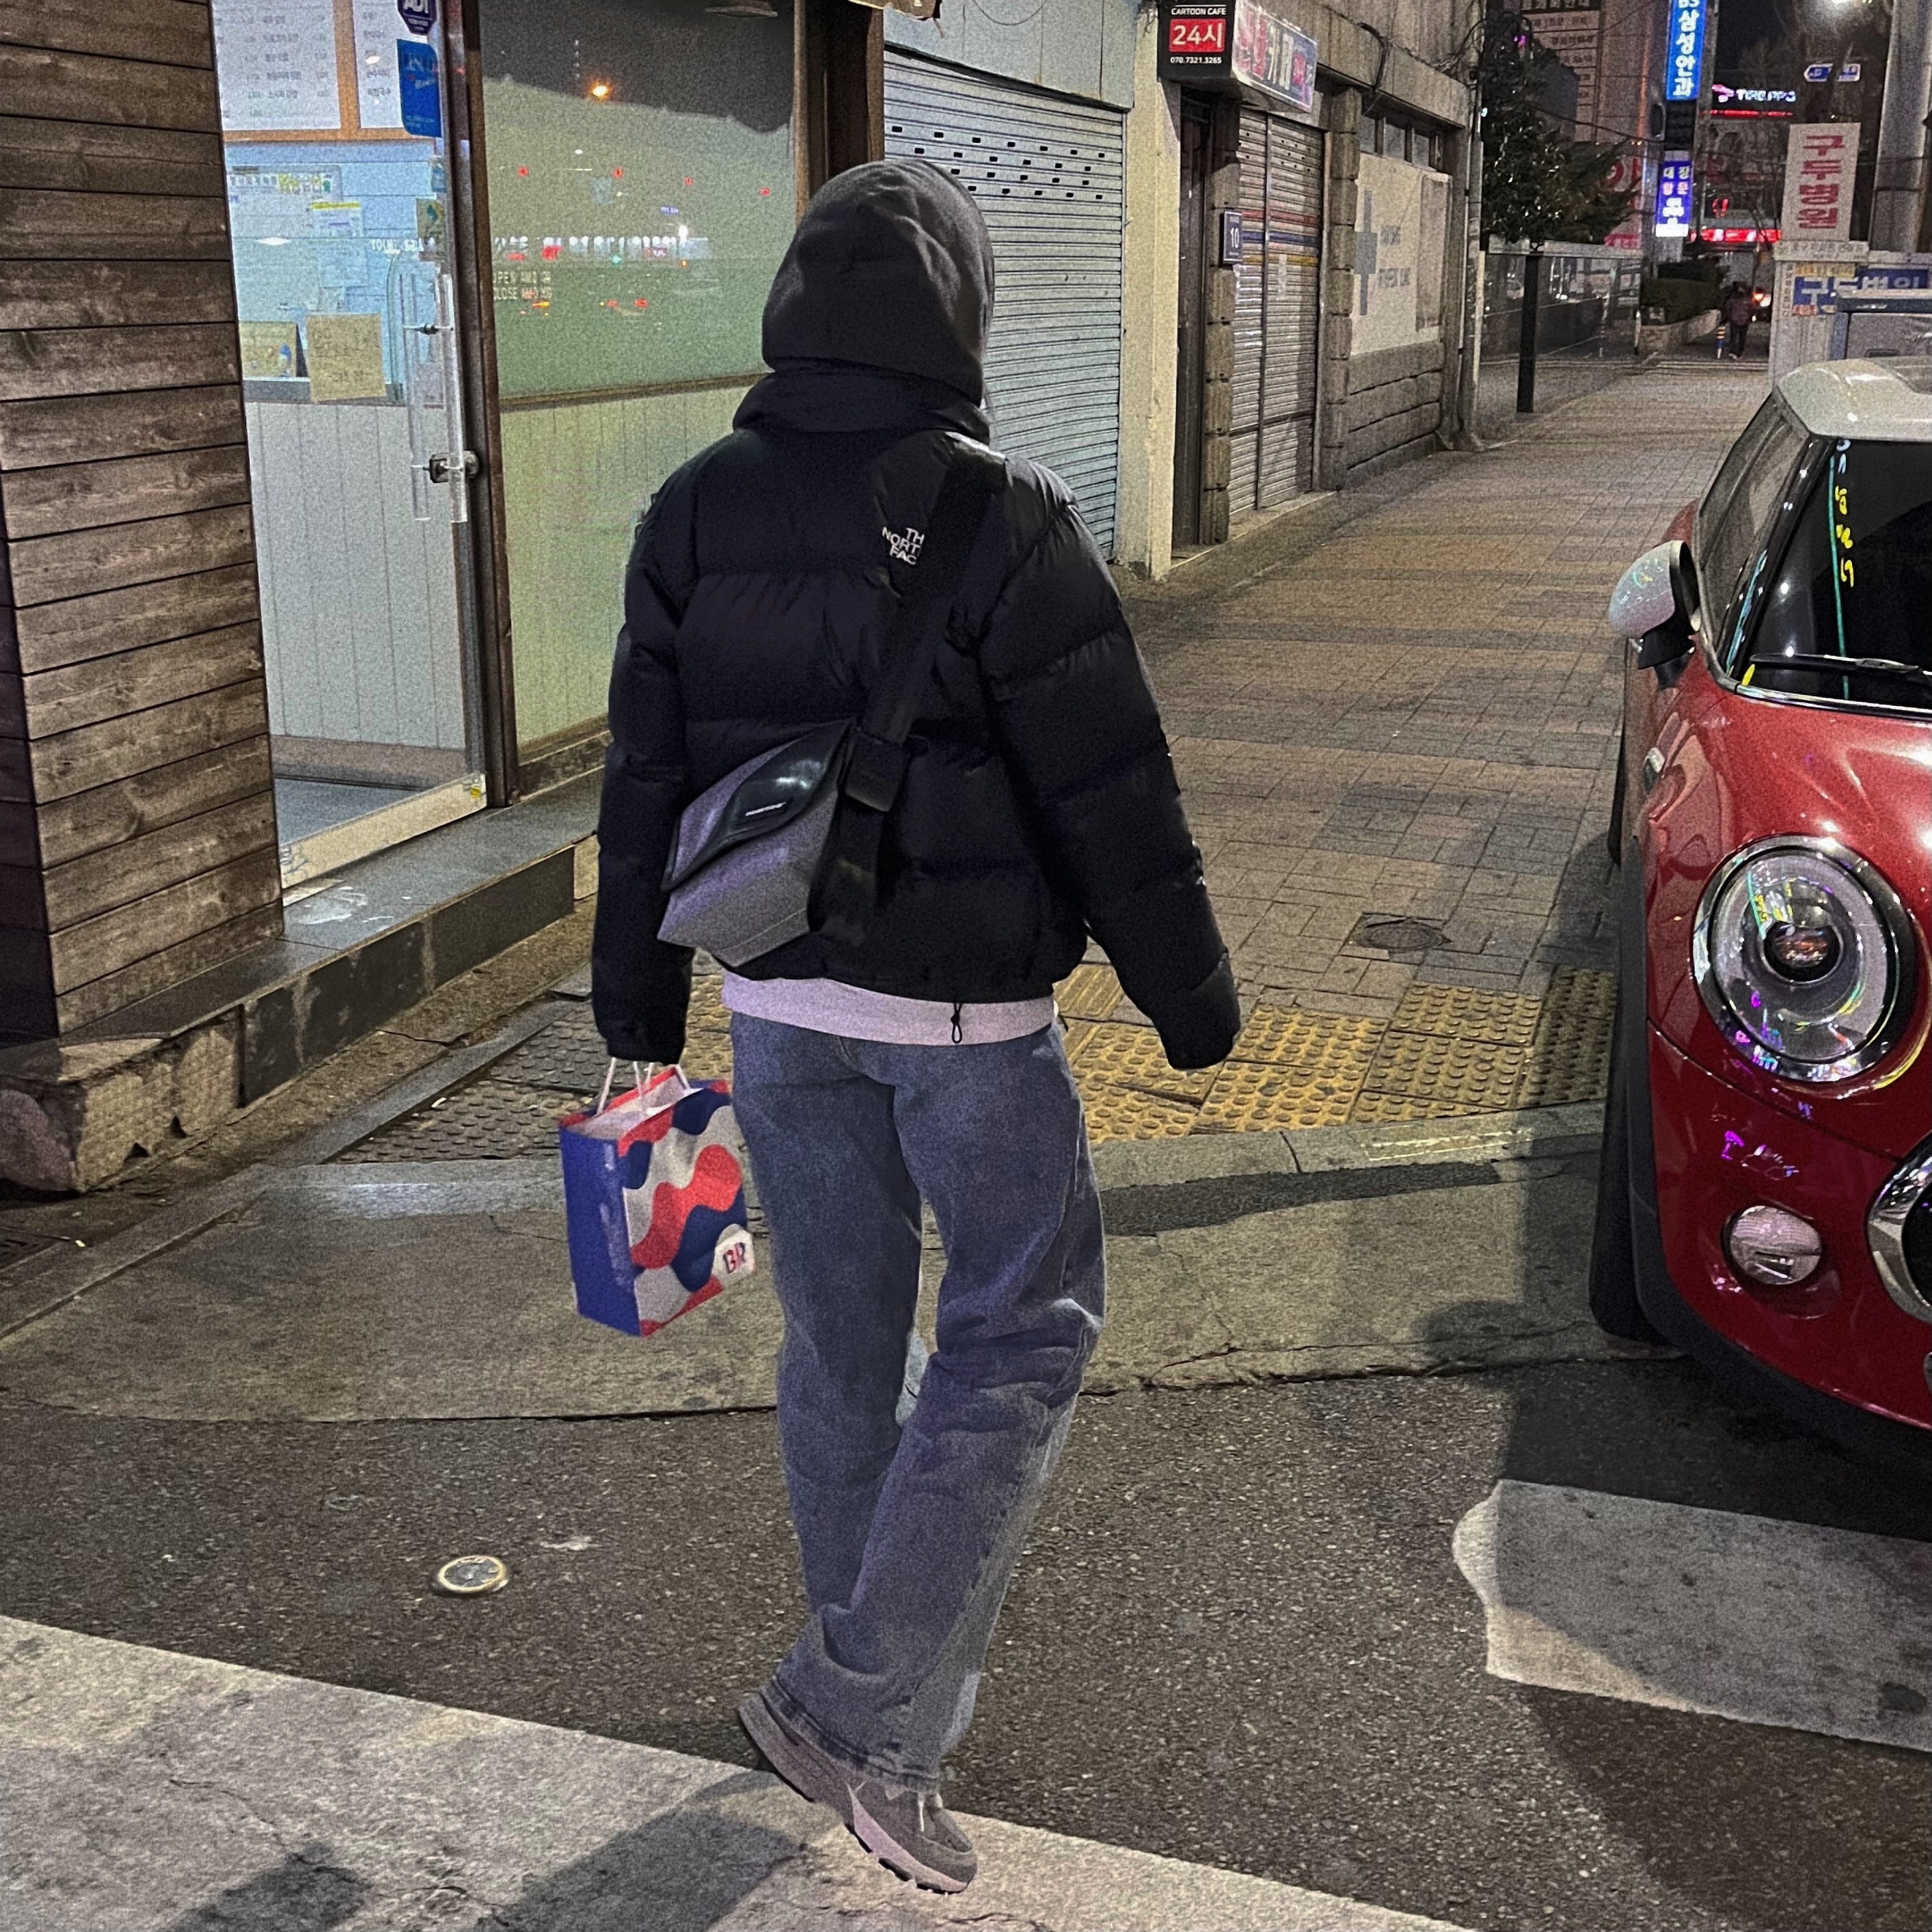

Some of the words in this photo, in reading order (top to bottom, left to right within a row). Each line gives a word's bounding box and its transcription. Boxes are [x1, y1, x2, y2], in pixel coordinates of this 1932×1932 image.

[1171, 8, 1206, 16] CARTOON
[1208, 8, 1226, 16] CAFE
[1172, 23, 1223, 49] 24시
[1797, 135, 1845, 230] 구두병원
[1230, 227, 1240, 248] 10
[882, 526, 921, 556] NORT
[889, 545, 917, 565] FAC
